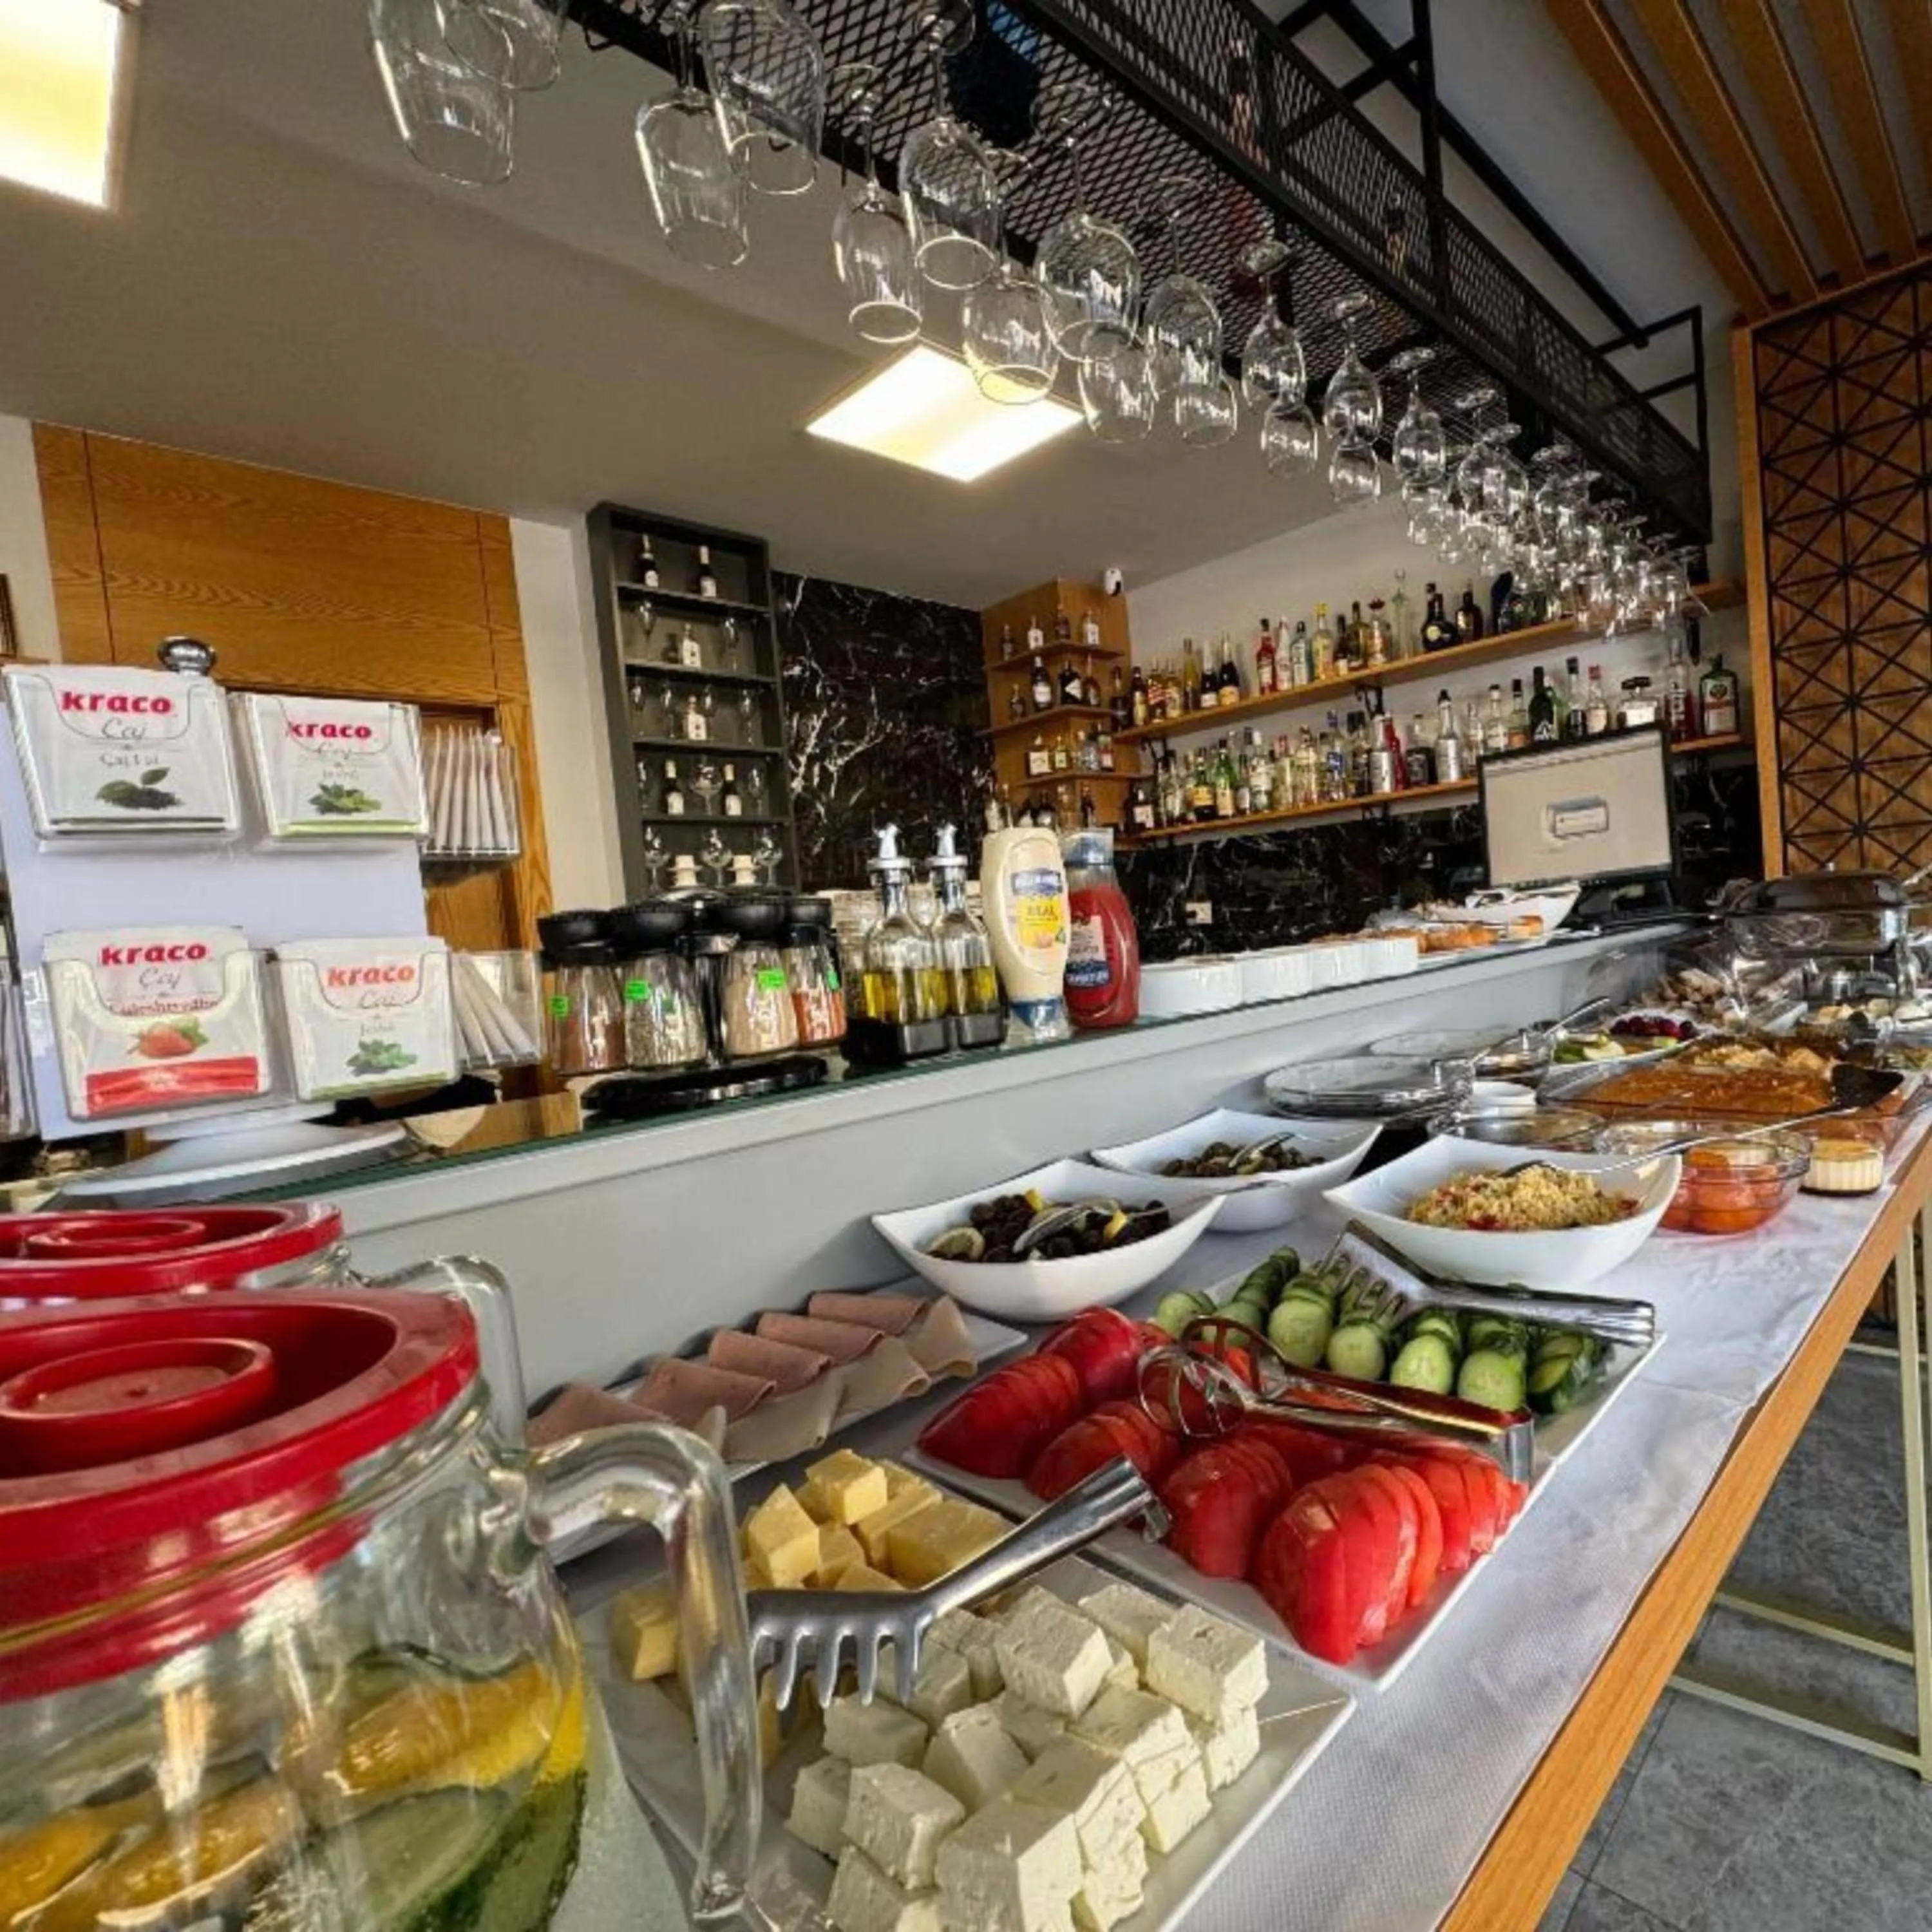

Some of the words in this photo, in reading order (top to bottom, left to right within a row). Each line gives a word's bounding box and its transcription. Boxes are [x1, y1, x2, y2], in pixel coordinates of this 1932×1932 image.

[62, 690, 172, 714] kraco
[287, 721, 372, 739] kraco
[100, 942, 207, 966] kraco
[327, 966, 414, 987] kraco
